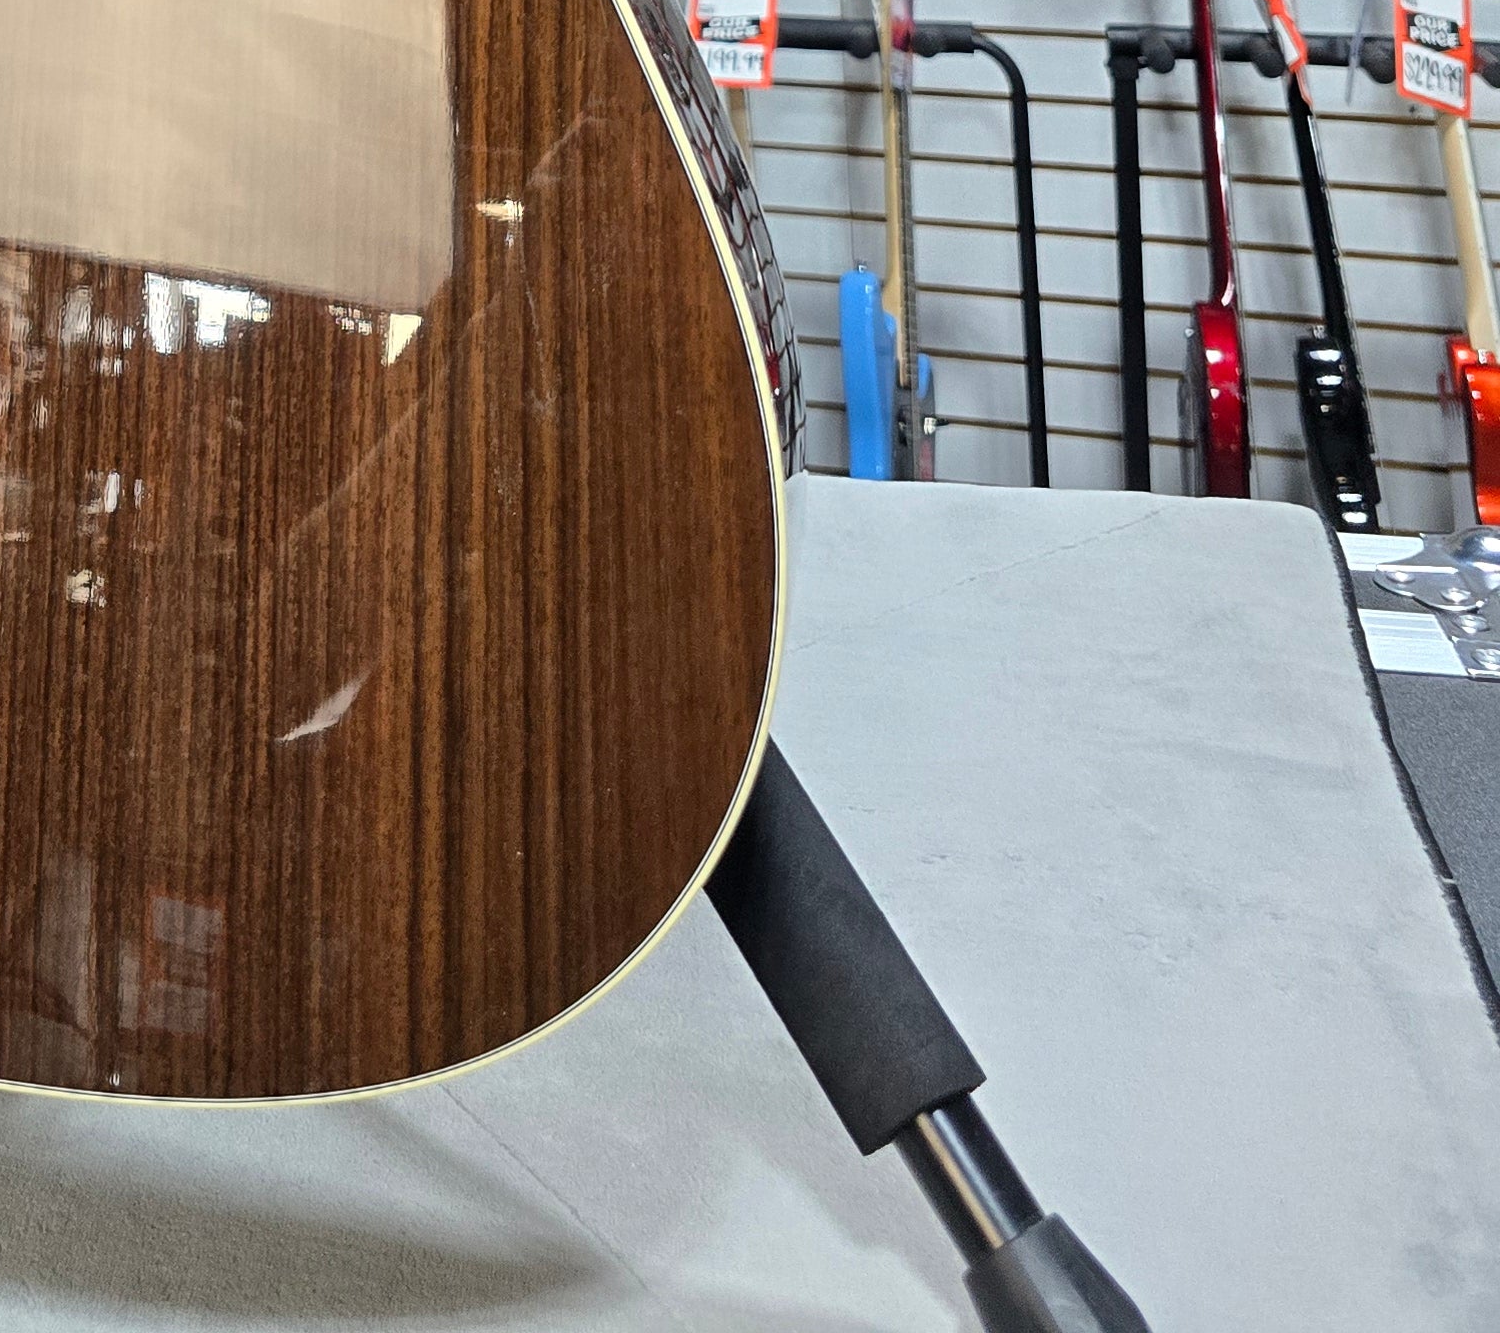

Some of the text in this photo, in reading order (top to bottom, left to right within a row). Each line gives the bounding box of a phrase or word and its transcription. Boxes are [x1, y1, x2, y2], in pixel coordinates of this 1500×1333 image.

[709, 16, 752, 28] OUR
[1413, 13, 1450, 32] OUR
[702, 25, 760, 41] PRICE
[1409, 25, 1460, 48] PRICE
